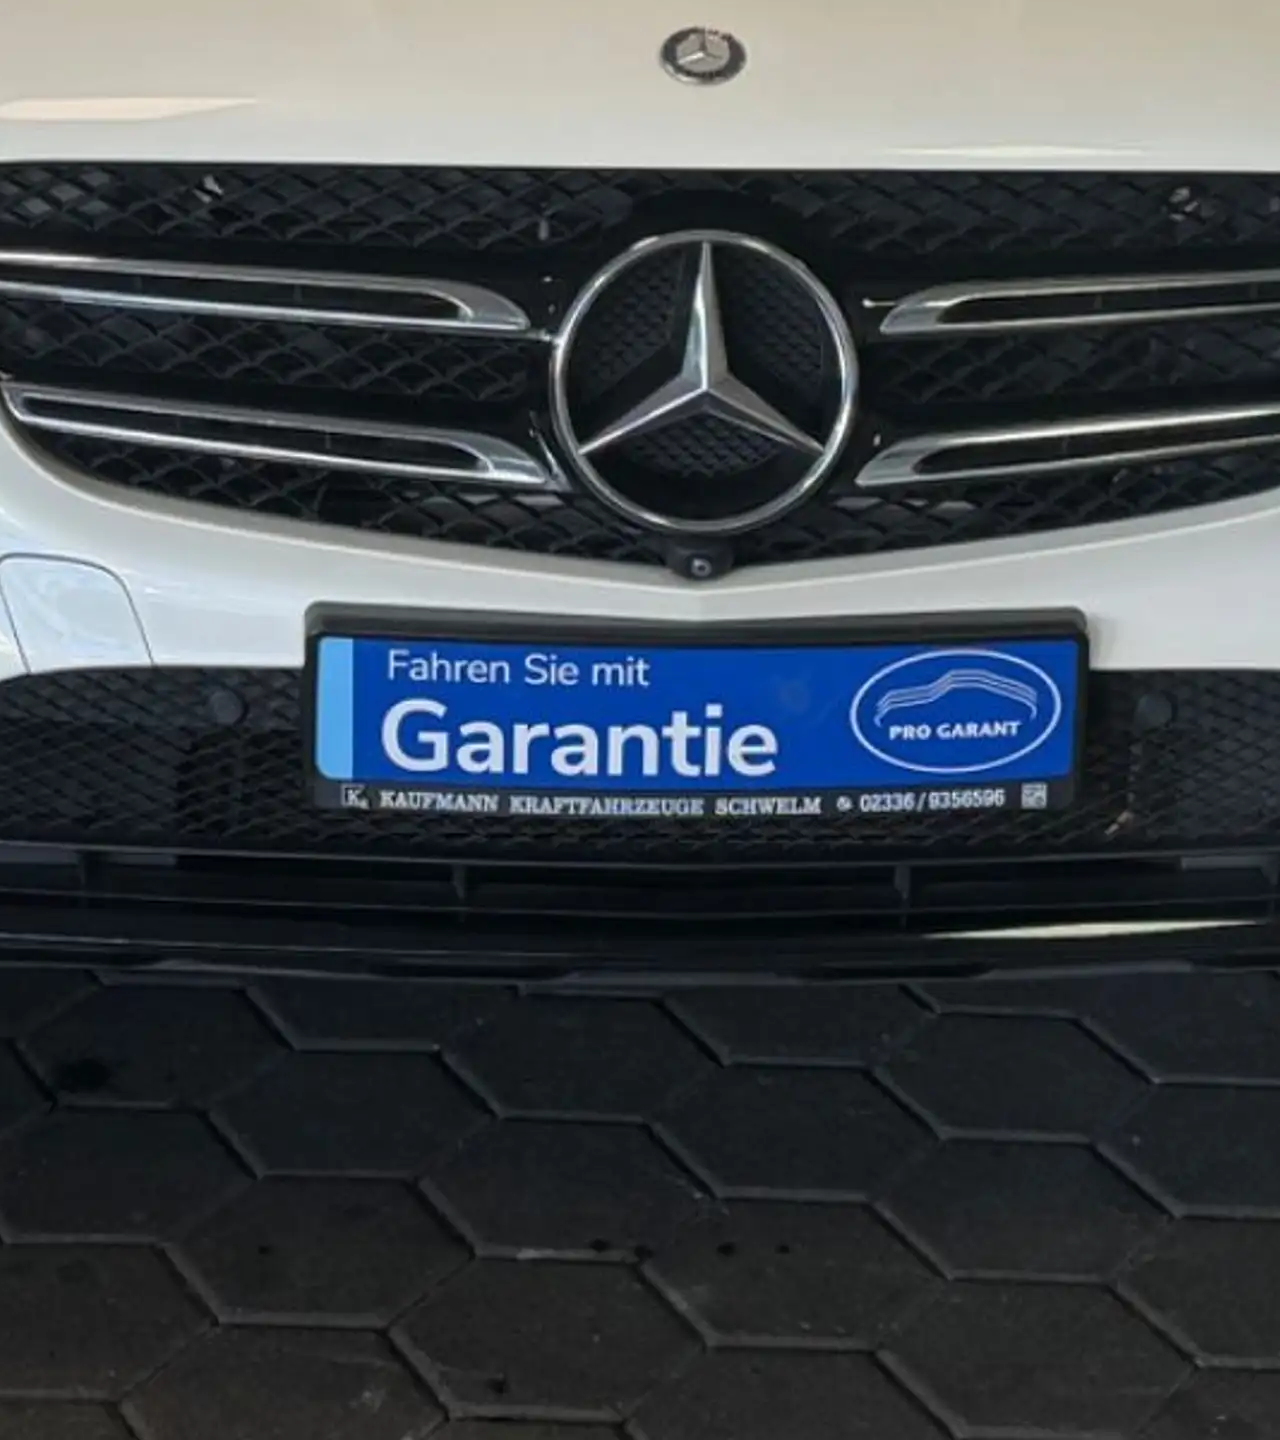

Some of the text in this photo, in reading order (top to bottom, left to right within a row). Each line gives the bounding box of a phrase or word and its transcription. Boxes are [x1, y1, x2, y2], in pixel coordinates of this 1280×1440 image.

[387, 649, 651, 687] Fahren Sie mit
[380, 698, 779, 777] Garantie
[888, 720, 1022, 741] PRO GARANT
[380, 789, 500, 813] KAUFMANN
[509, 794, 705, 816] KRAFTFAHRZEUGE
[714, 796, 822, 816] SCHWELM
